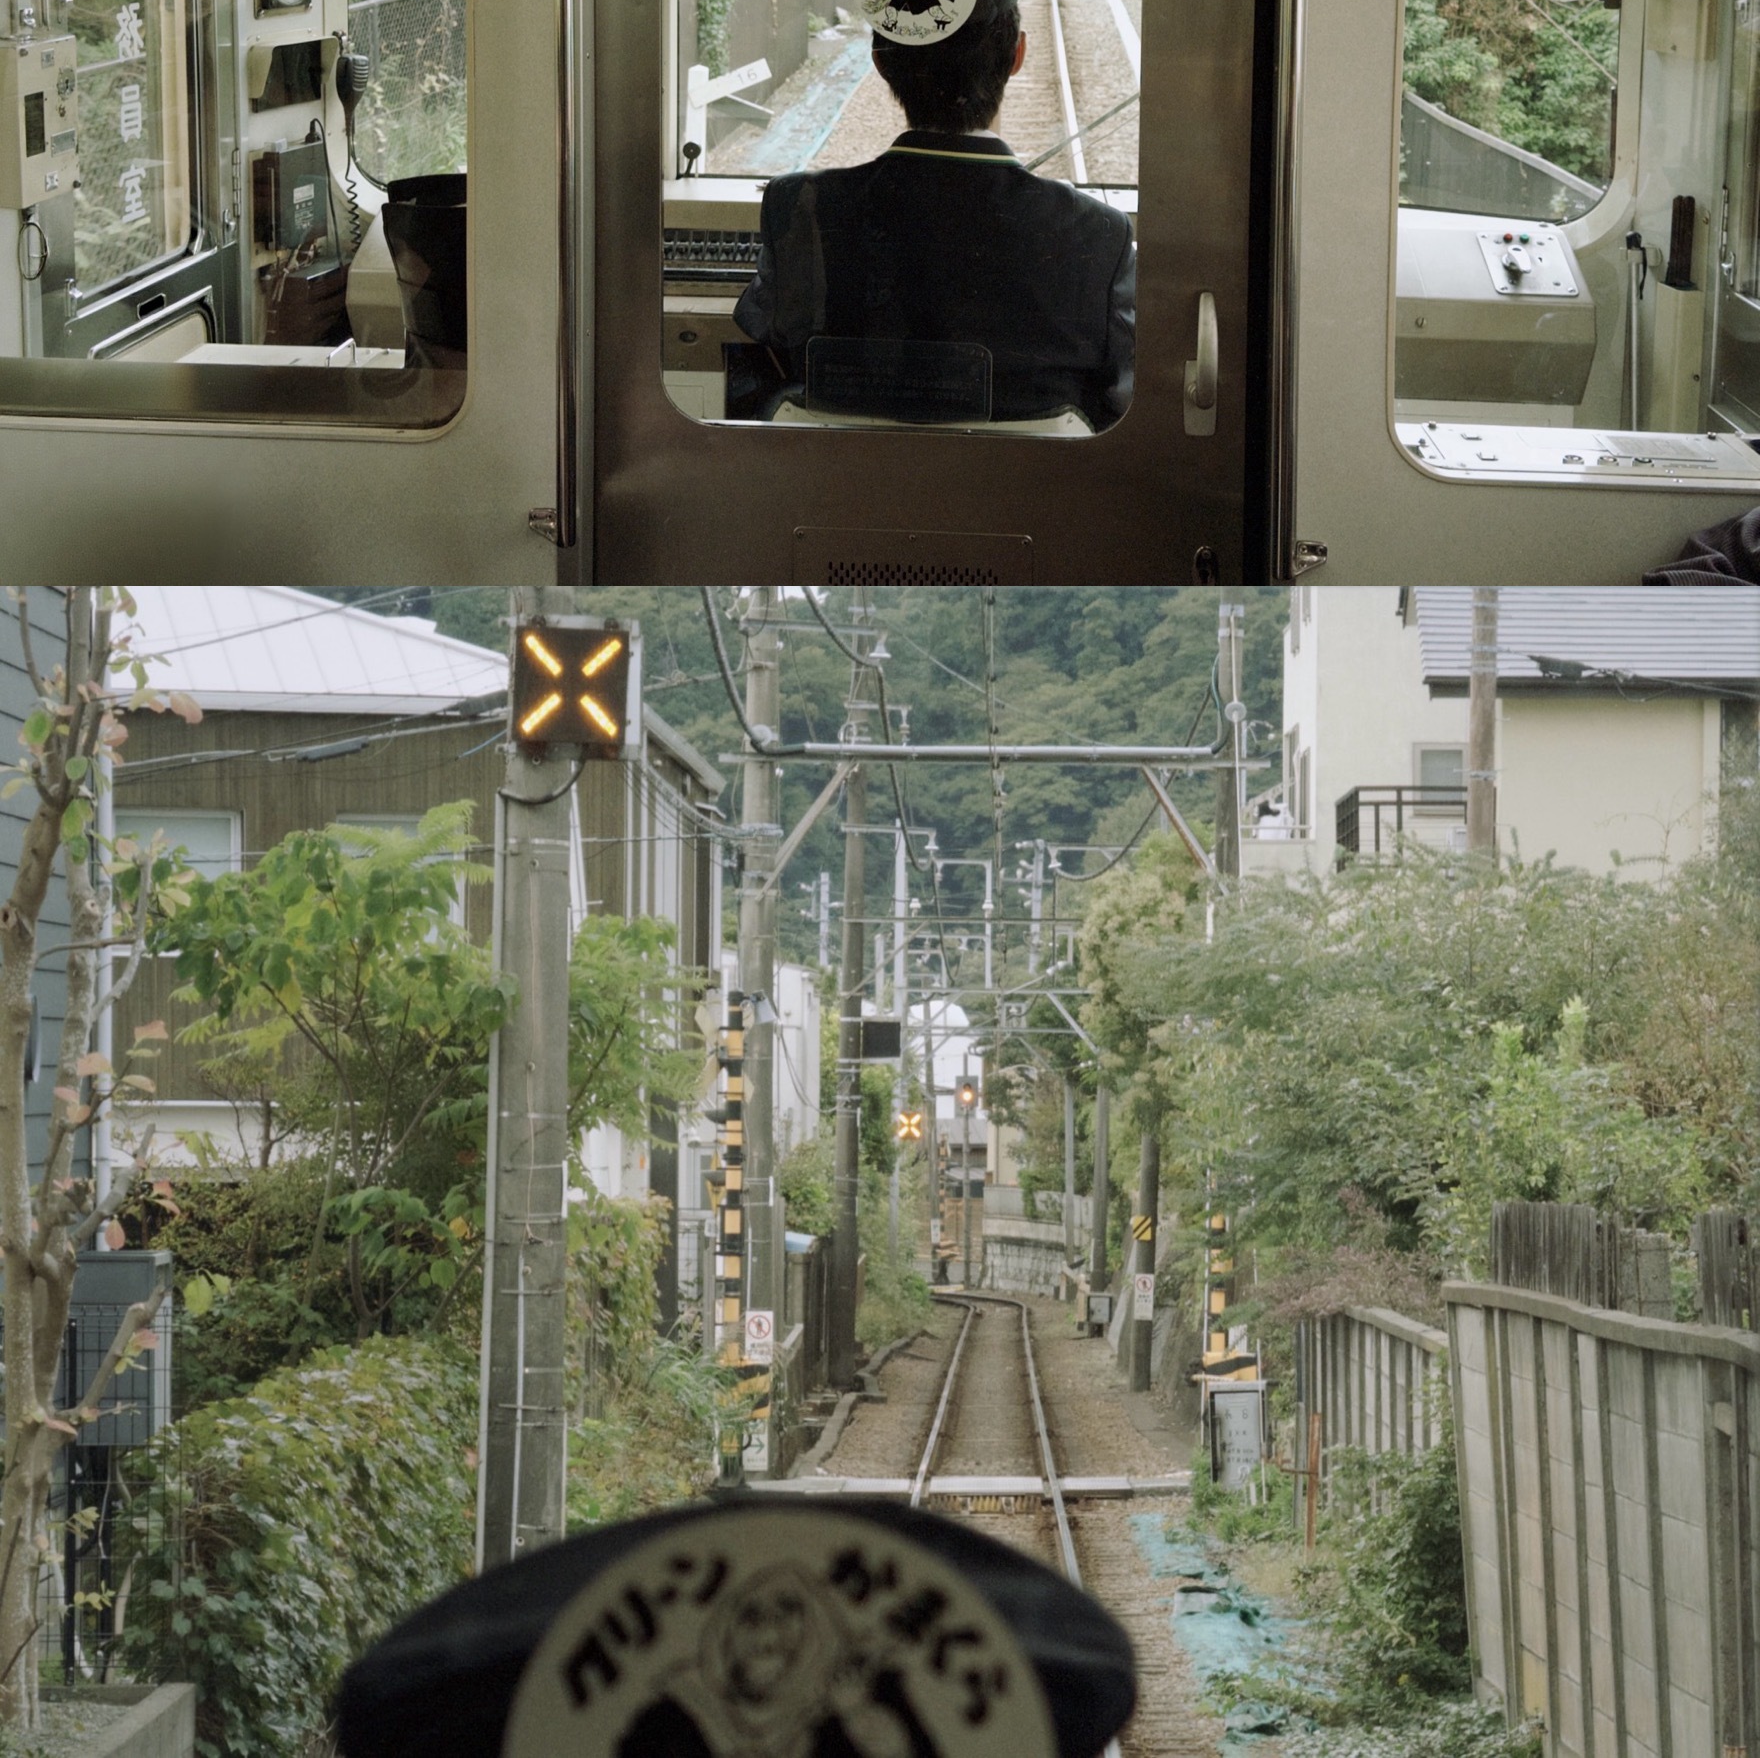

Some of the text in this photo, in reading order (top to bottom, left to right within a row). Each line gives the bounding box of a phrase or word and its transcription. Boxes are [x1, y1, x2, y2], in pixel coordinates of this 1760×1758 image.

[559, 1550, 733, 1712] クリーン
[828, 1544, 1013, 1730] かまくら
